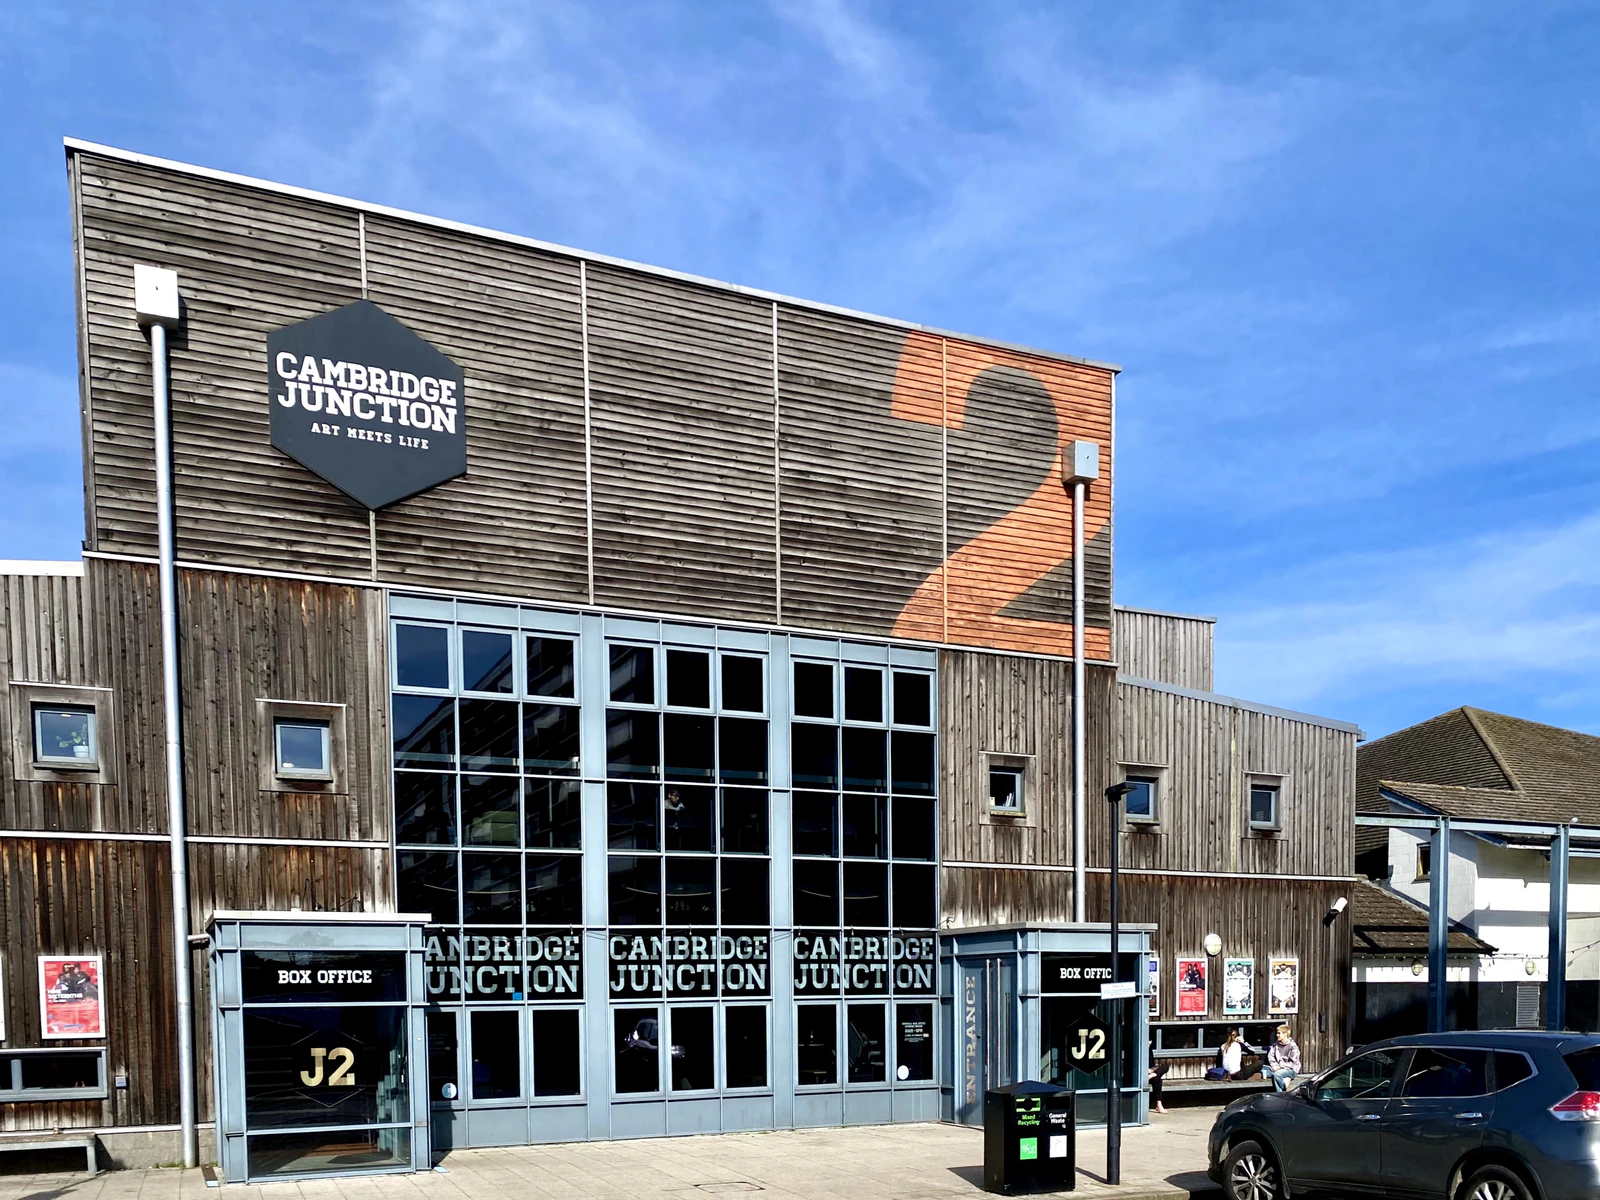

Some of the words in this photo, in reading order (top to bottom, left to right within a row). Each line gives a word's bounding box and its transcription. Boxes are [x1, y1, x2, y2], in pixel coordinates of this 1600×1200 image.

[276, 351, 457, 407] CAMBRIDGE
[277, 381, 457, 434] JUNCTION
[311, 422, 340, 436] ART
[347, 427, 392, 444] MEETS
[399, 435, 429, 450] LIFE
[425, 935, 580, 961] AMBRIDGE
[609, 935, 768, 960] CAMBRIDGE
[793, 936, 934, 960] CAMBRIDGE
[278, 969, 312, 984] BOX
[317, 969, 373, 984] OFFICE
[425, 965, 580, 994] UNCTION
[610, 963, 768, 991] JUNCTION
[1060, 967, 1081, 979] BOX
[1084, 967, 1112, 979] OFFIC
[965, 976, 977, 1105] ENTRANCE
[1071, 1028, 1106, 1060] J2
[300, 1047, 355, 1087] J2
[1017, 1119, 1040, 1127] Recycling
